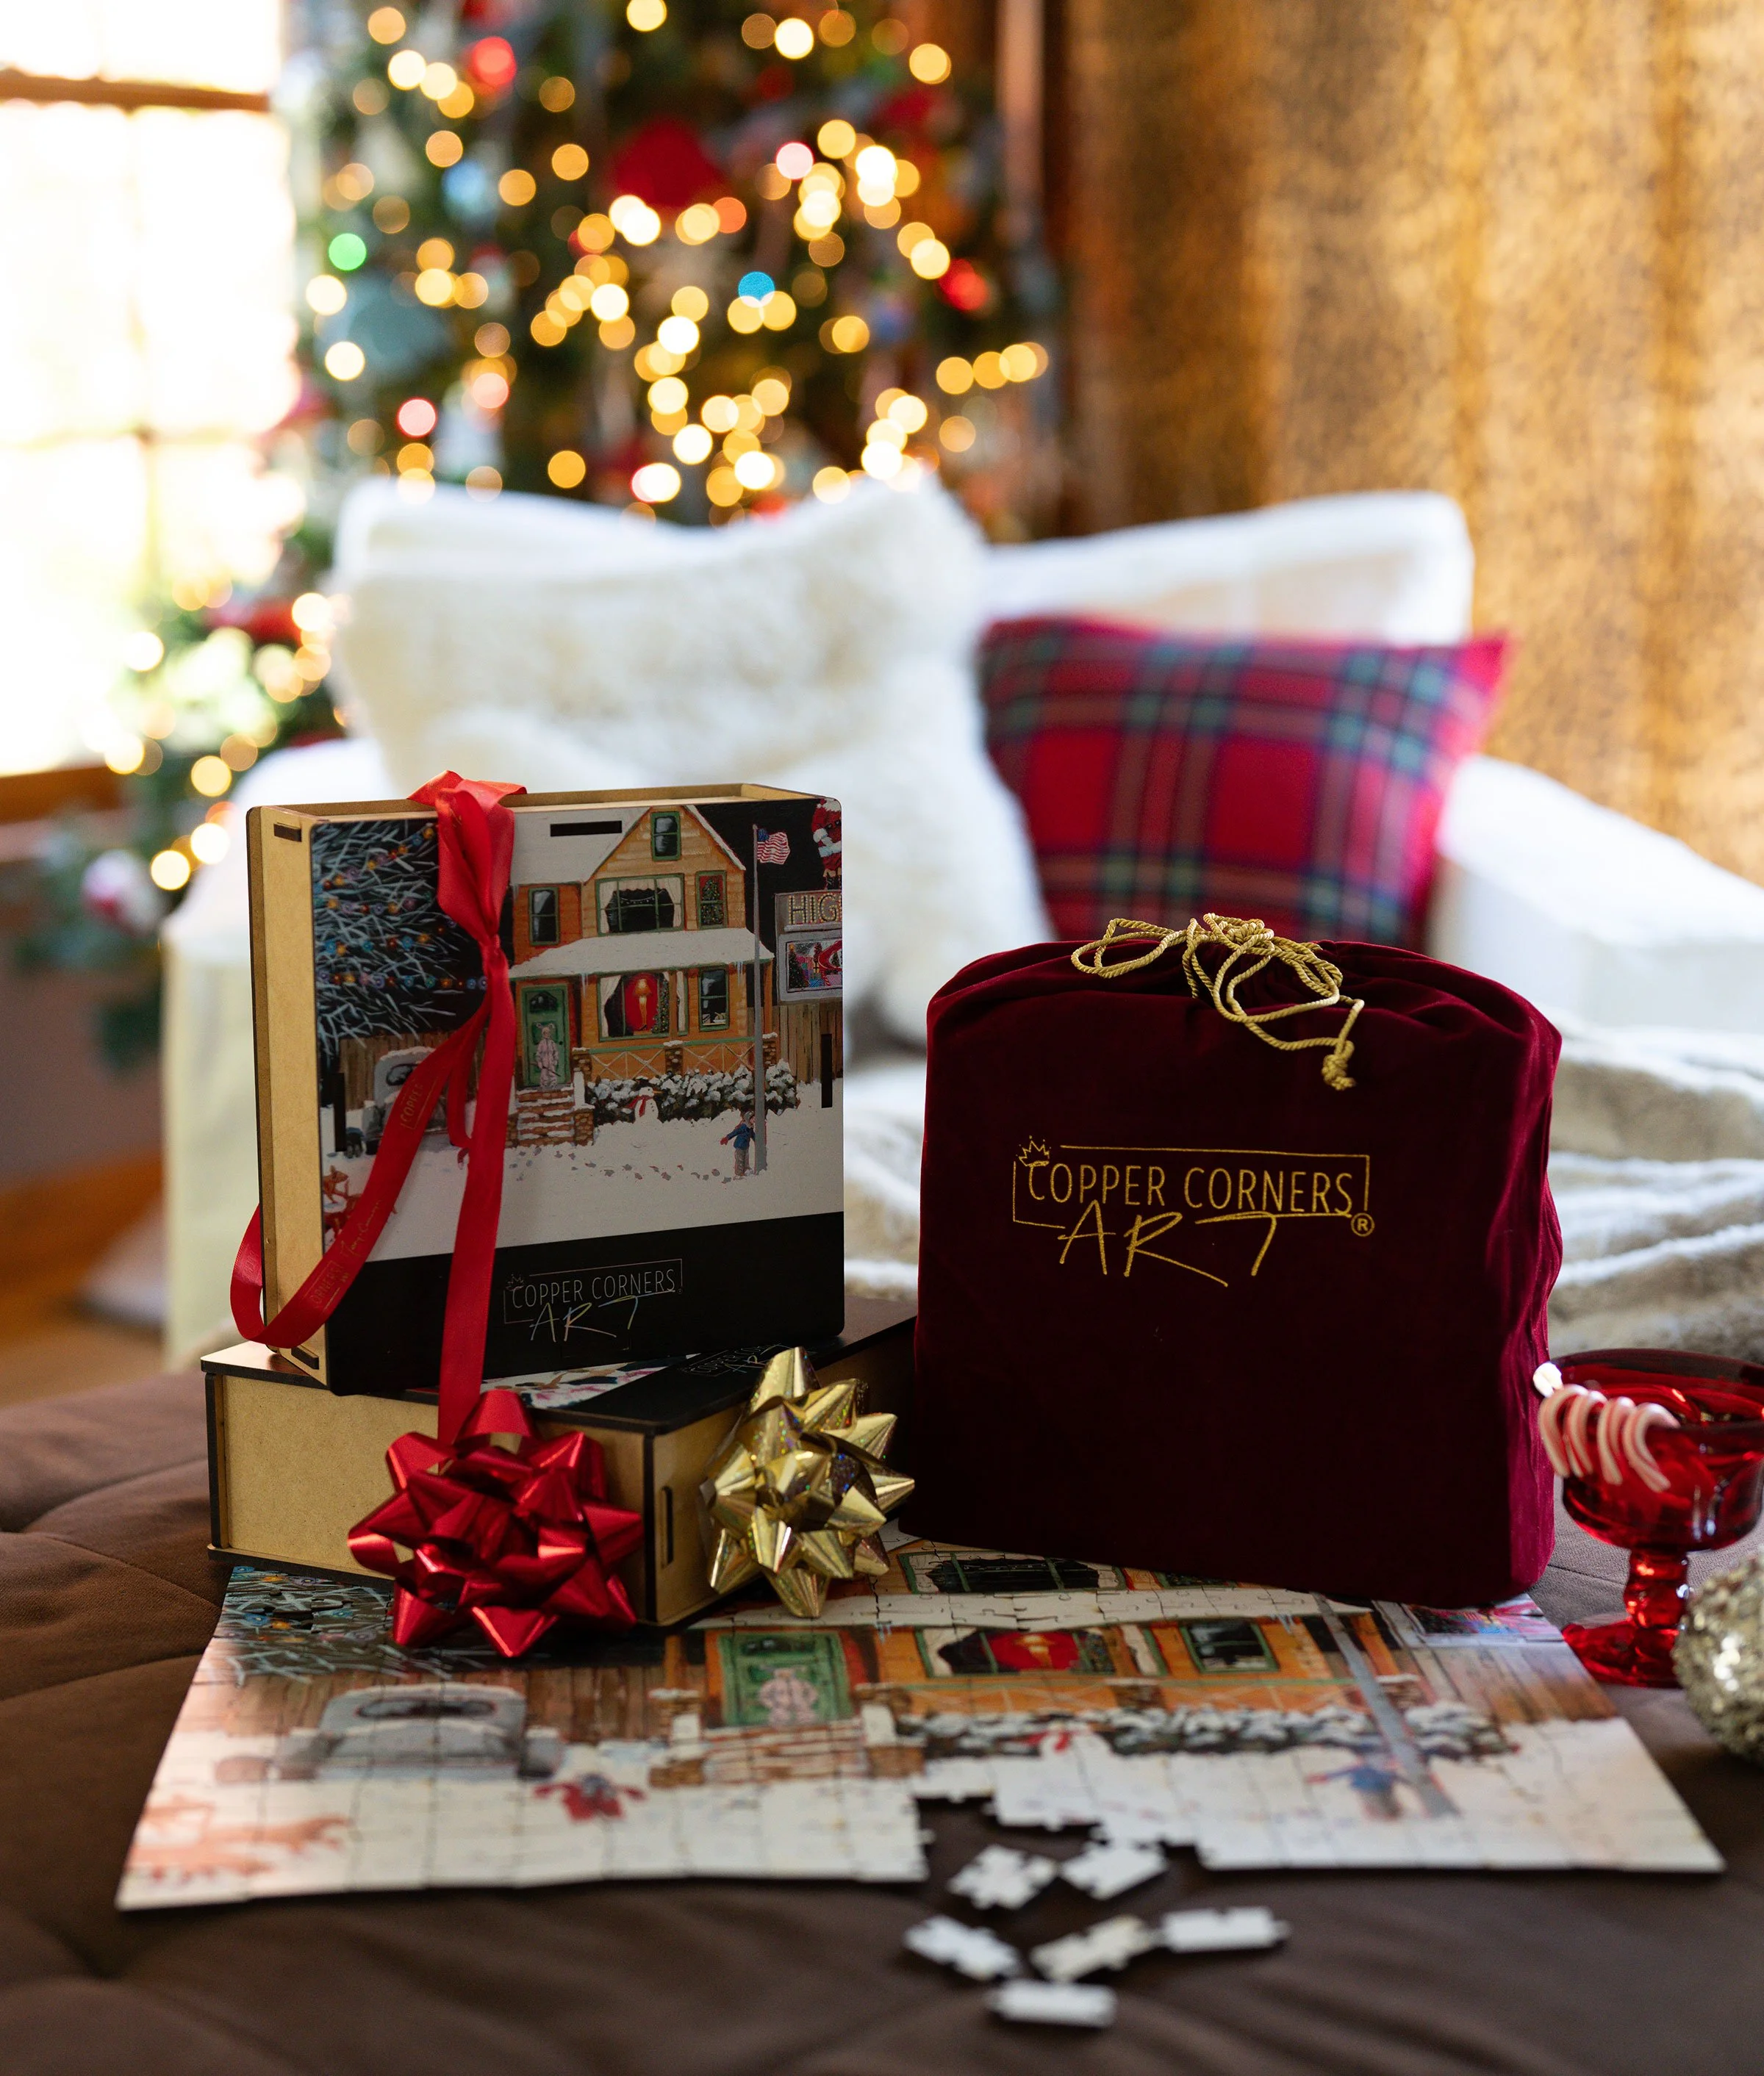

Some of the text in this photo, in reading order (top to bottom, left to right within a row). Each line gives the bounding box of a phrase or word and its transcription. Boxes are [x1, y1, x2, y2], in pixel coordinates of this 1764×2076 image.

[1028, 1160, 1353, 1215] COPPER CORNERS
[1057, 1199, 1277, 1287] ART
[512, 1268, 675, 1309] COPPER CORNERS
[528, 1295, 639, 1343] ART
